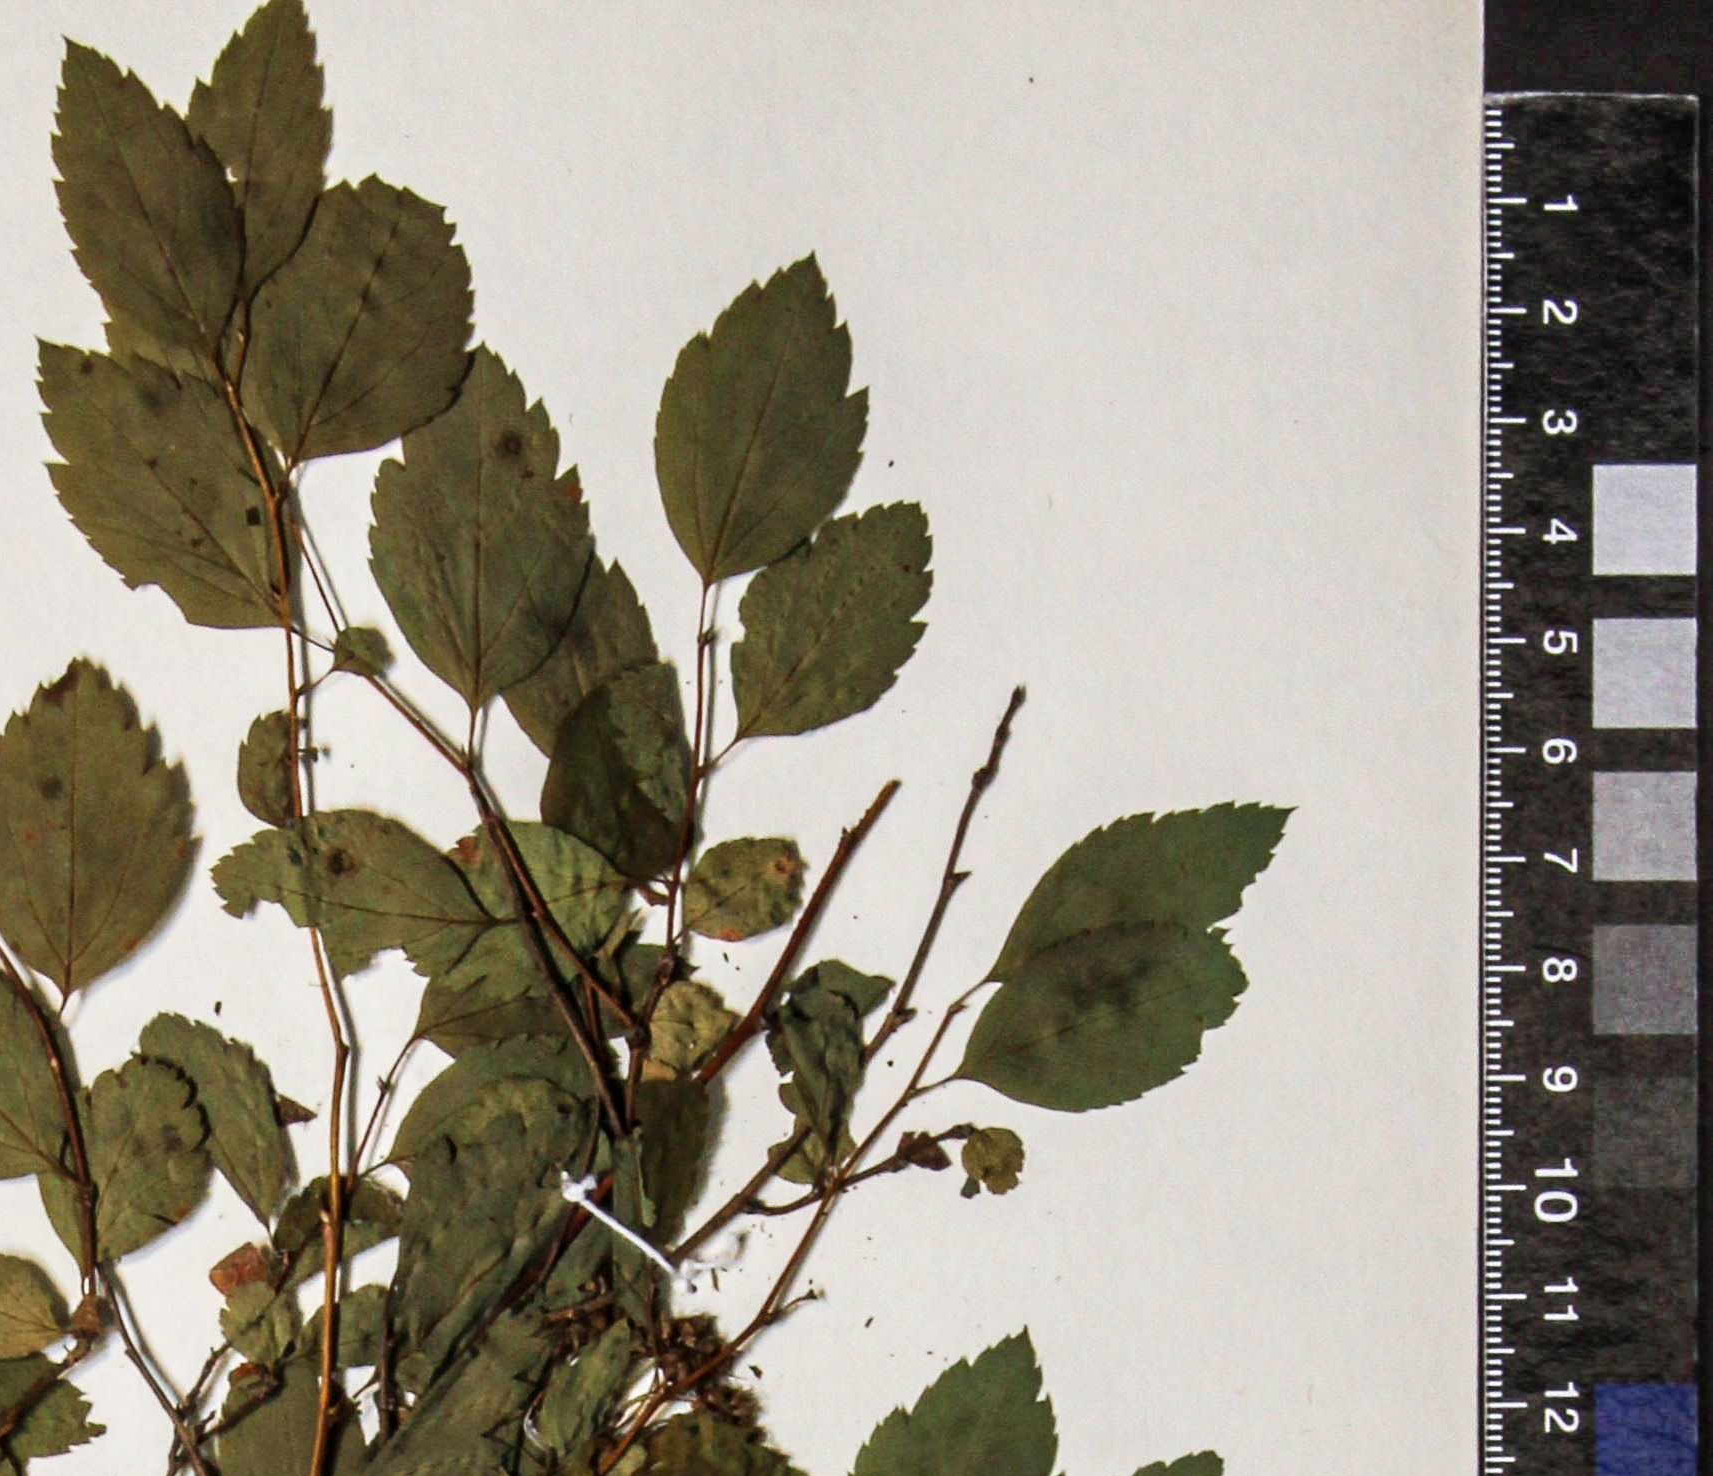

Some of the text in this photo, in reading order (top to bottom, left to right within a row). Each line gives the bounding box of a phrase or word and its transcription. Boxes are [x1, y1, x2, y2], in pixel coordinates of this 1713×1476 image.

[1542, 194, 1579, 212] 1
[1542, 298, 1579, 325] 2
[1540, 408, 1579, 436] 3
[1542, 517, 1579, 545] 4
[1542, 629, 1579, 655] 5
[1541, 737, 1578, 765] 6
[1543, 847, 1579, 874] 7
[1541, 956, 1578, 983] 8
[1542, 1065, 1579, 1093] 9
[1533, 1157, 1579, 1223] 10
[1542, 1276, 1580, 1322] 11
[1543, 1381, 1580, 1434] 12
